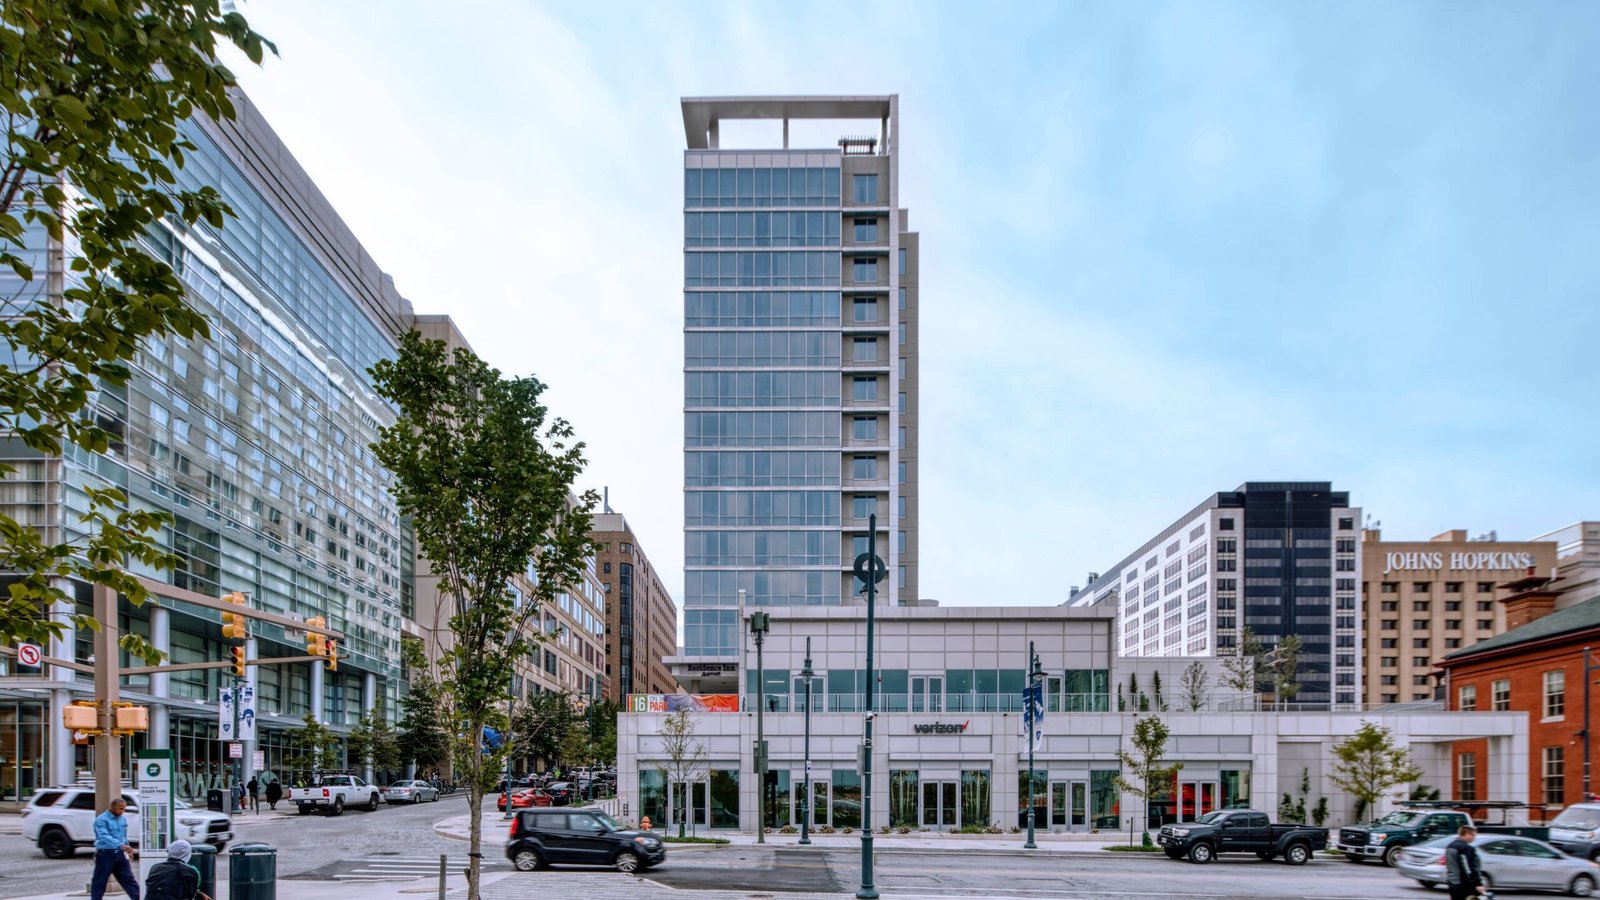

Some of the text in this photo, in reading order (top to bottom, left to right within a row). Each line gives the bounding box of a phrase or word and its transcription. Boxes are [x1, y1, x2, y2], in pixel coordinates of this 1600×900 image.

[1383, 552, 1531, 574] JOHNS HOPKINS
[688, 663, 735, 671] Residence Inn
[634, 696, 646, 712] 16
[650, 702, 667, 712] PARK
[914, 721, 963, 734] verizon
